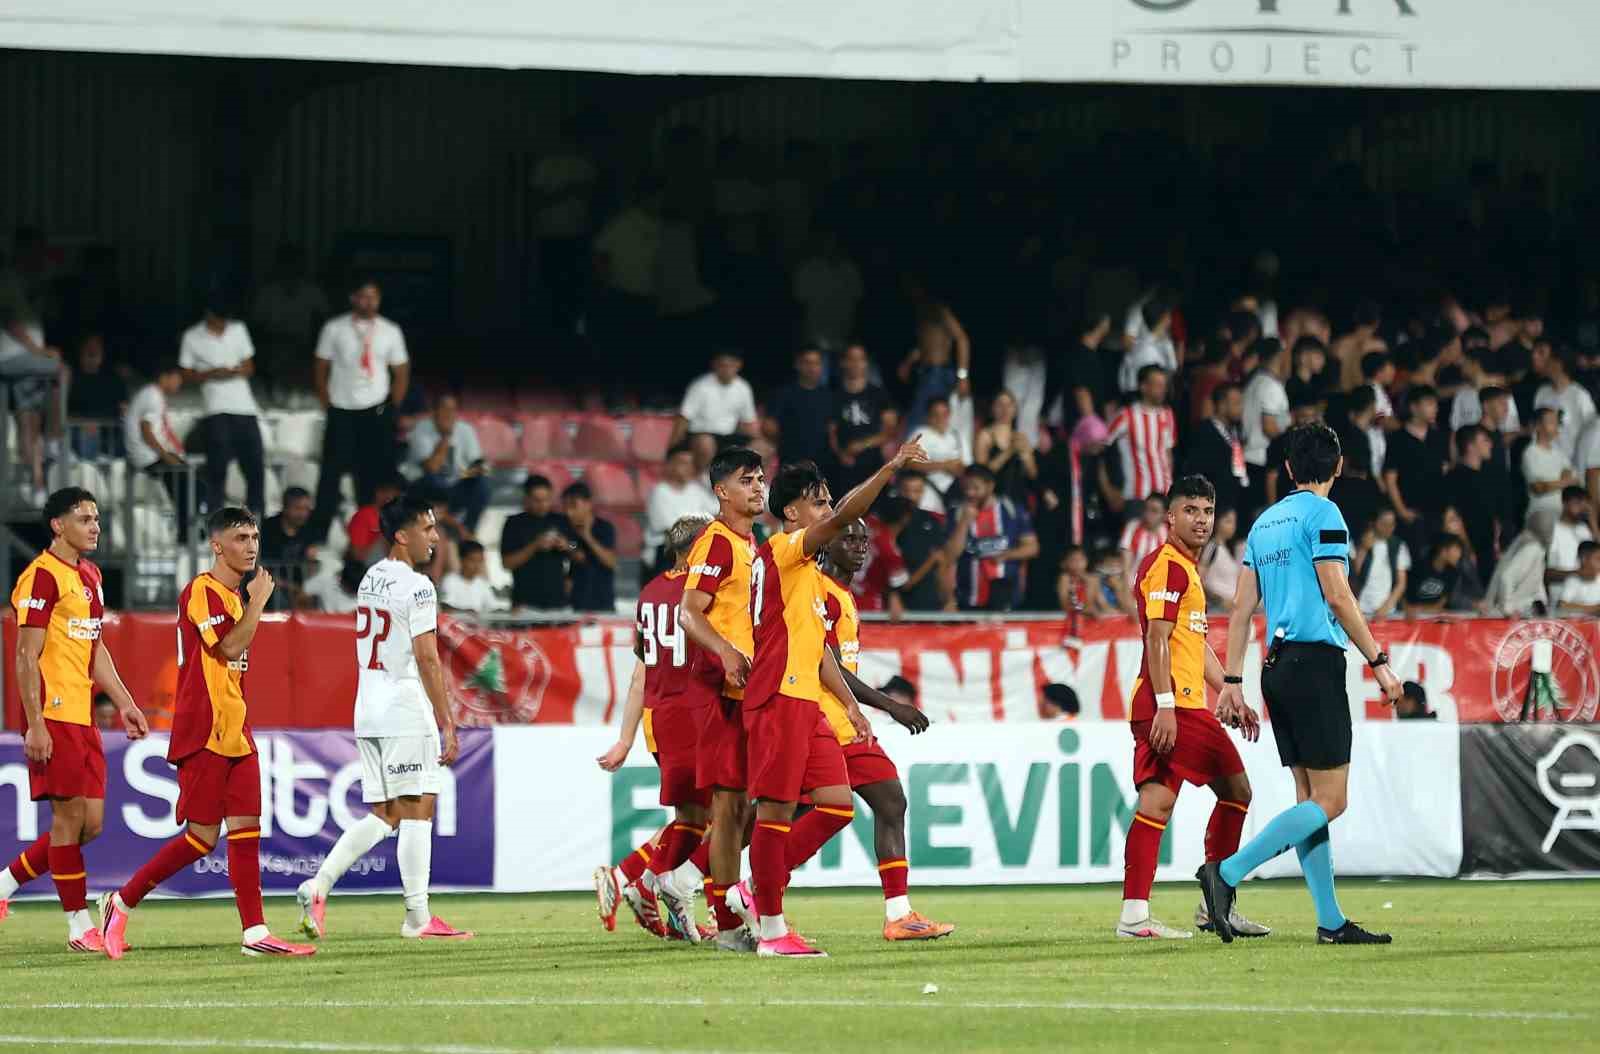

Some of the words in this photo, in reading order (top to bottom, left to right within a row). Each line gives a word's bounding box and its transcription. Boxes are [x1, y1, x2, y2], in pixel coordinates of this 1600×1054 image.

[1111, 39, 1420, 75] PROJECT
[640, 601, 687, 667] 34
[386, 761, 423, 776] Sultan
